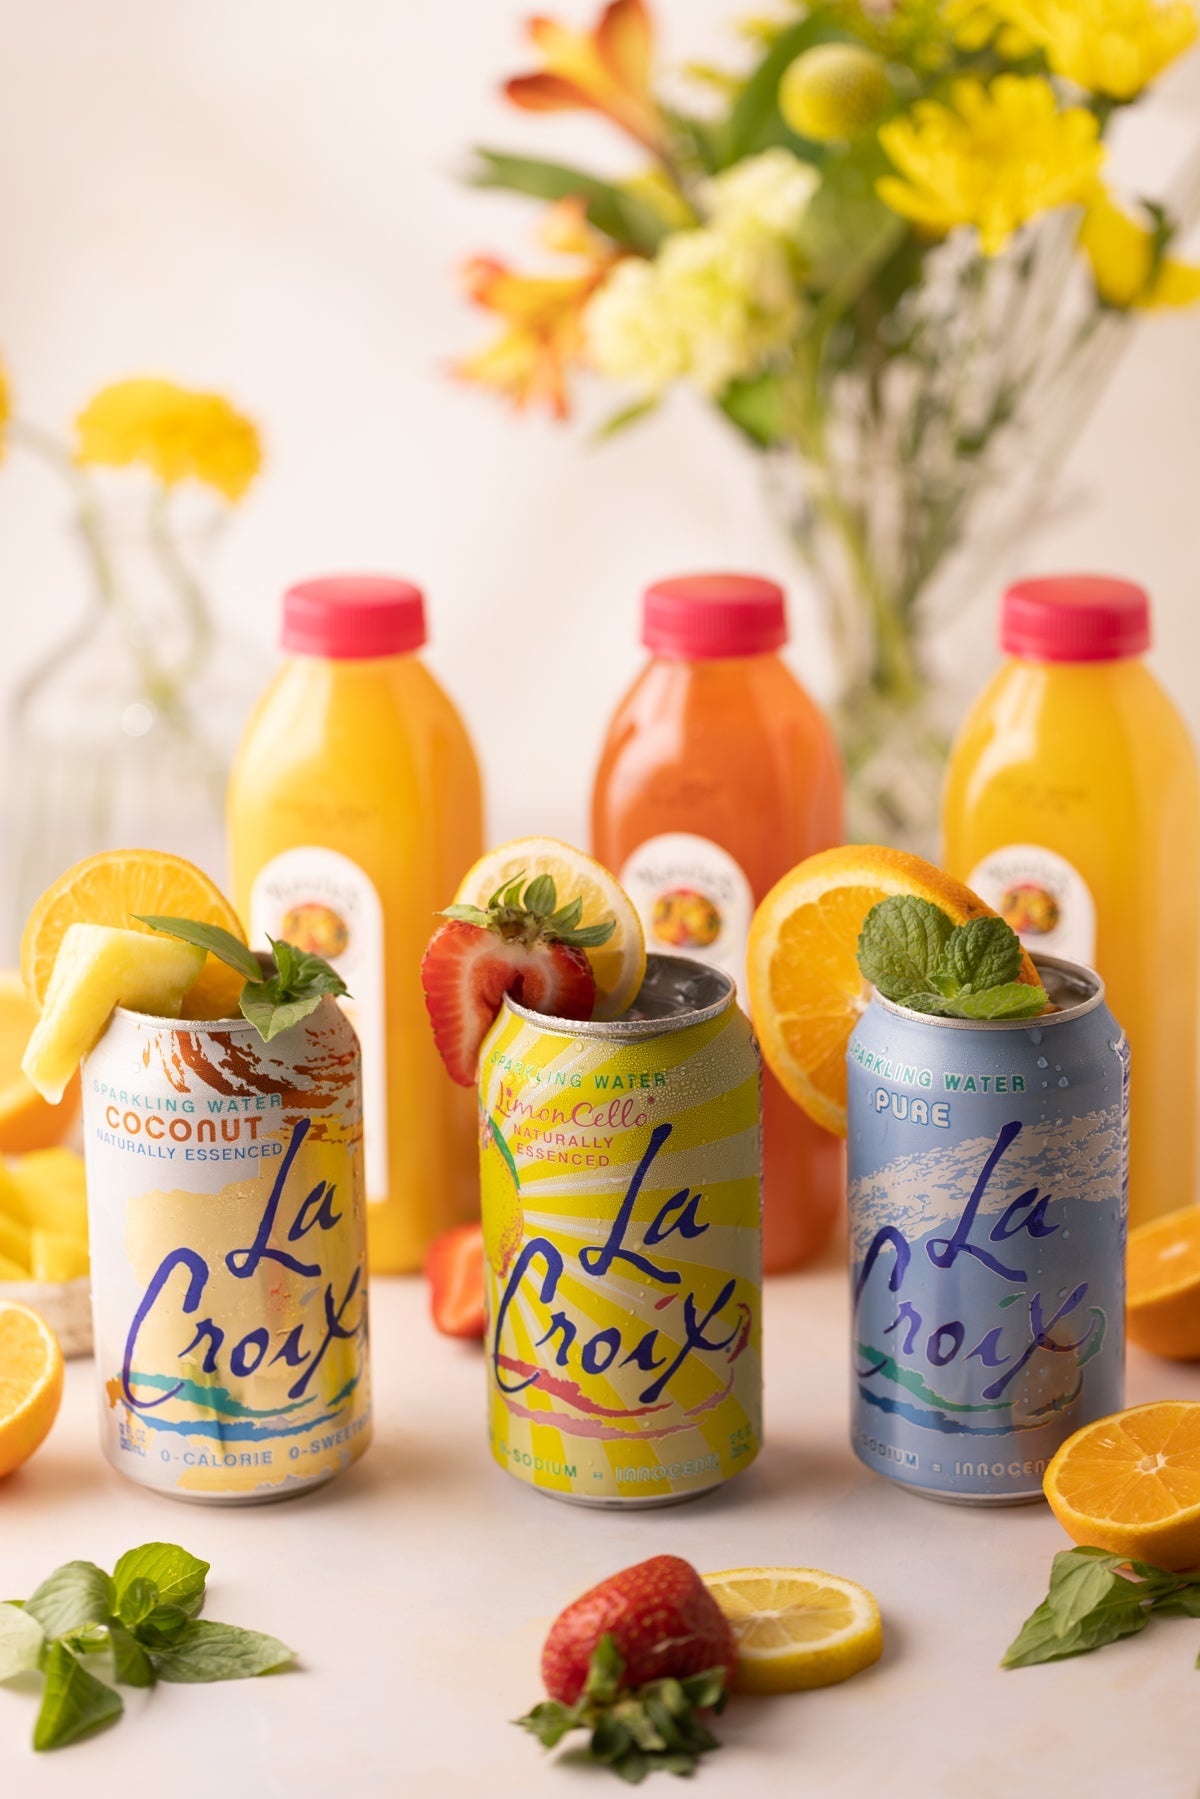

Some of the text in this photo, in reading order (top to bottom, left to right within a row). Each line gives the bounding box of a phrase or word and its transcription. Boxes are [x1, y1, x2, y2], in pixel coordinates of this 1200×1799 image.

[490, 1050, 667, 1089] SPARKLING WATER
[943, 1073, 1026, 1093] WATER
[93, 1080, 282, 1114] SPARKLING WATER
[495, 1080, 648, 1128] LimonCello
[874, 1087, 951, 1129] PURE
[106, 1105, 262, 1143] COCONUT
[513, 1124, 614, 1149] NATURALLY
[96, 1127, 283, 1161] NATURALLY ESSENCED
[516, 1143, 610, 1167] ESSENCED
[225, 1118, 342, 1279] La
[578, 1123, 710, 1284] La
[926, 1121, 1060, 1283] La
[161, 1449, 273, 1468] 0-CALORIE
[954, 1457, 1050, 1478] INNOCEN
